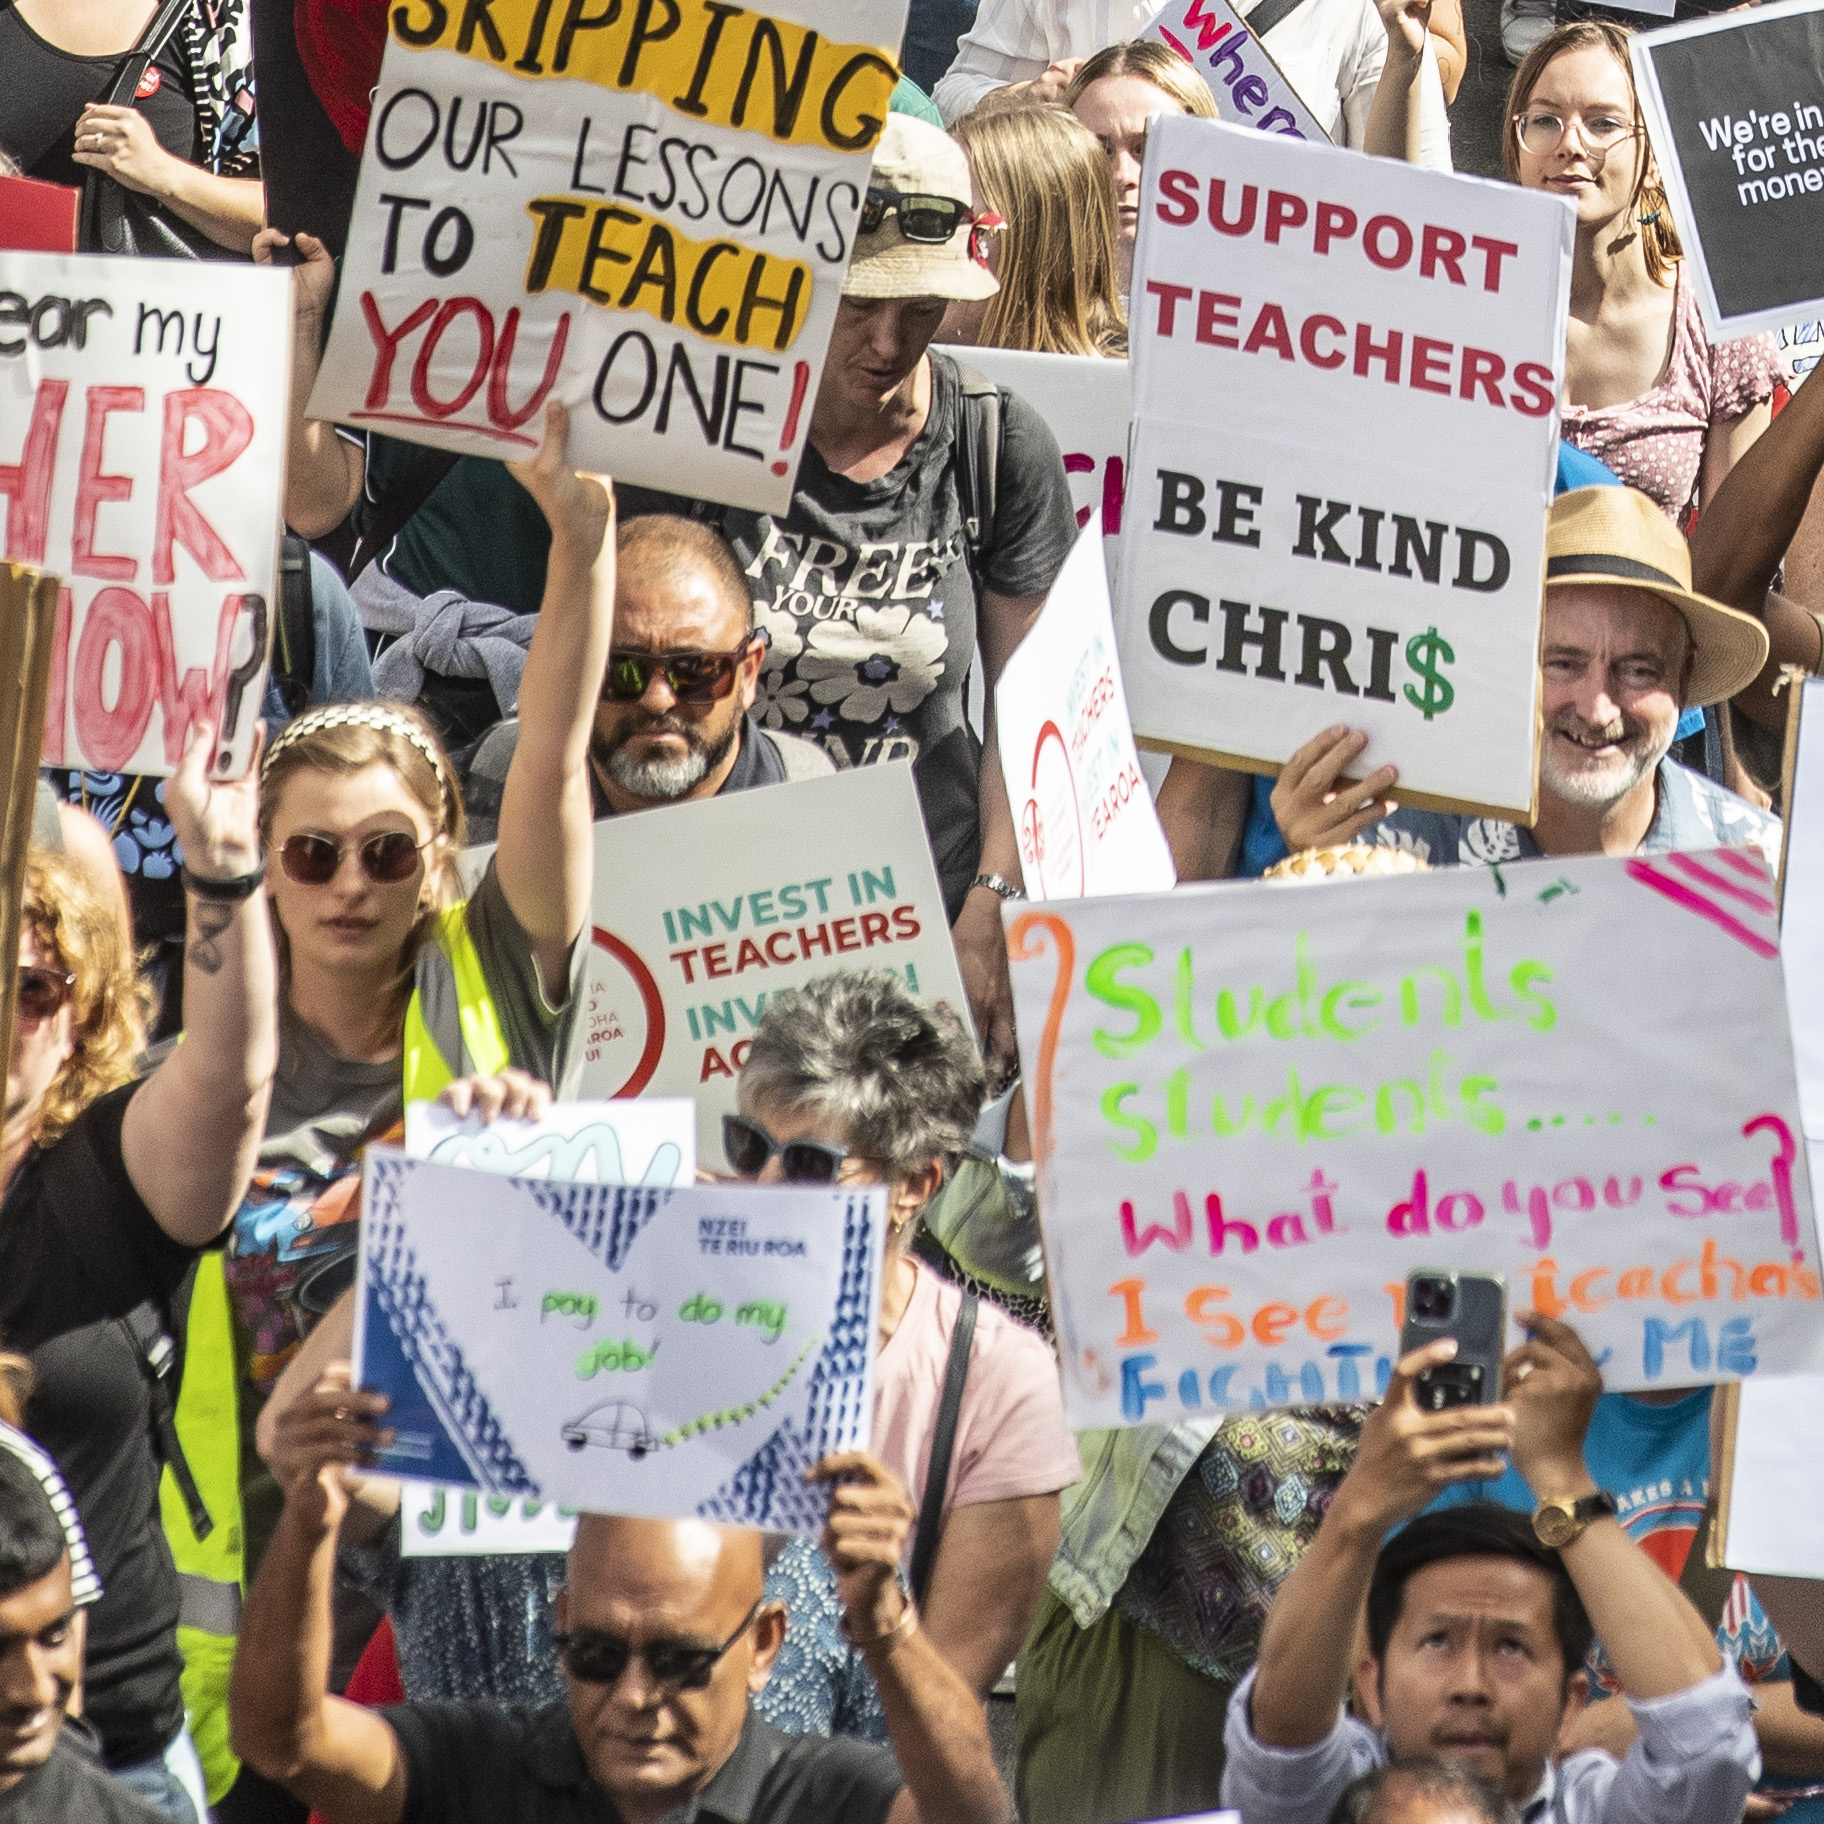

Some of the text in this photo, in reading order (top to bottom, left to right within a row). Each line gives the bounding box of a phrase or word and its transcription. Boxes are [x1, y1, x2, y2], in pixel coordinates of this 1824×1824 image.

[377, 88, 859, 265] OUR LESSONS
[1156, 170, 1517, 295] SUPPORT
[377, 194, 813, 349] TO TEACH
[360, 292, 809, 478] YOU ONE!
[1146, 280, 1556, 419] TEACHERS
[1155, 468, 1512, 594] BE KIND
[1149, 590, 1457, 720] CHRI$
[541, 1288, 787, 1339] pay to do my
